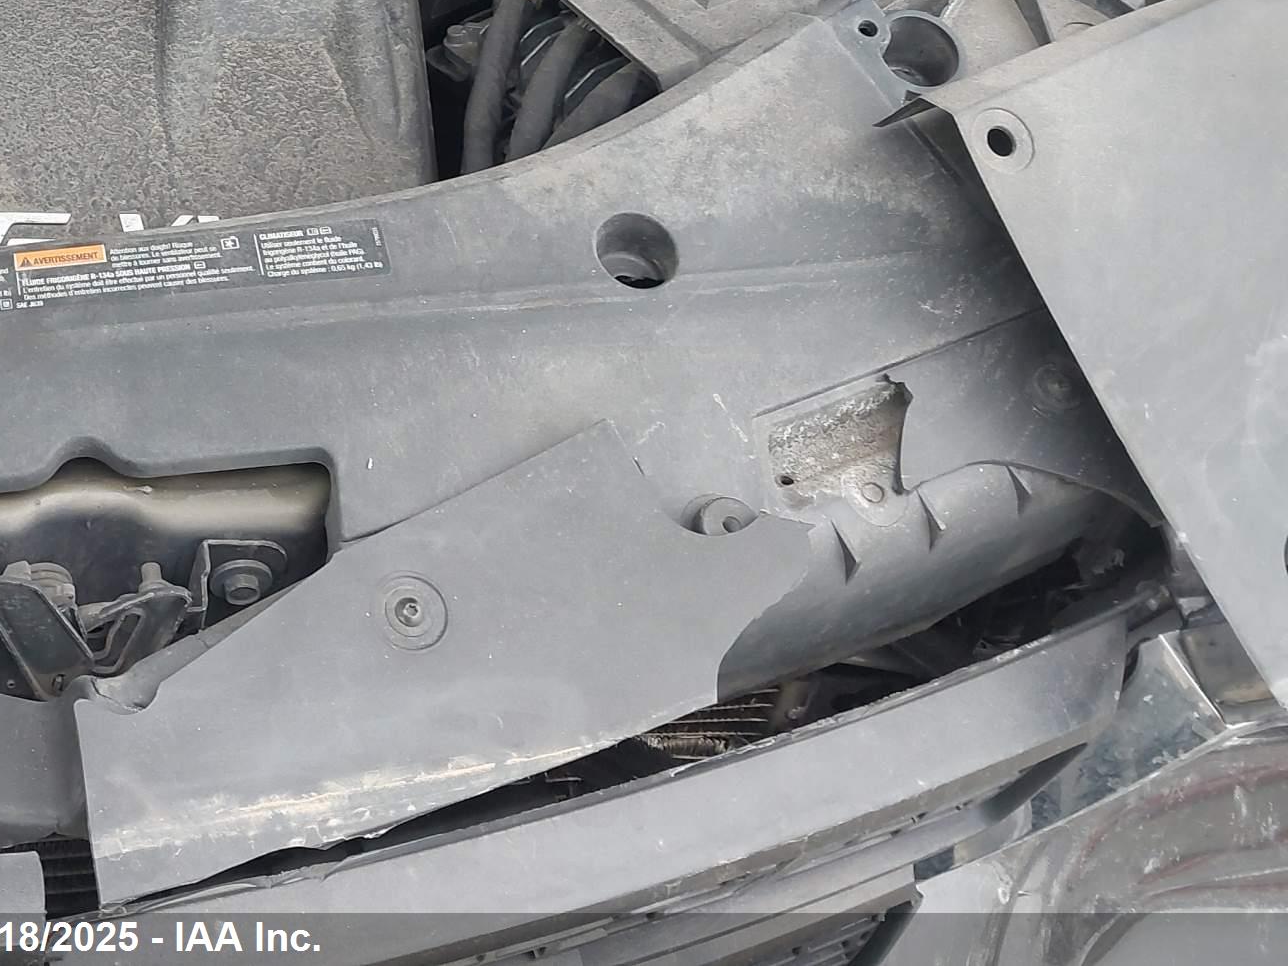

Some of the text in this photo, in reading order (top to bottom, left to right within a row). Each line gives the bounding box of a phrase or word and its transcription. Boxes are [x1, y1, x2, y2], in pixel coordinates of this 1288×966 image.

[259, 229, 304, 240] CLIMATISEUR
[33, 252, 99, 265] AVERTISSEMENT
[115, 269, 134, 277] SOUS
[134, 266, 157, 275] HAUTE
[157, 263, 191, 273] PRESSION
